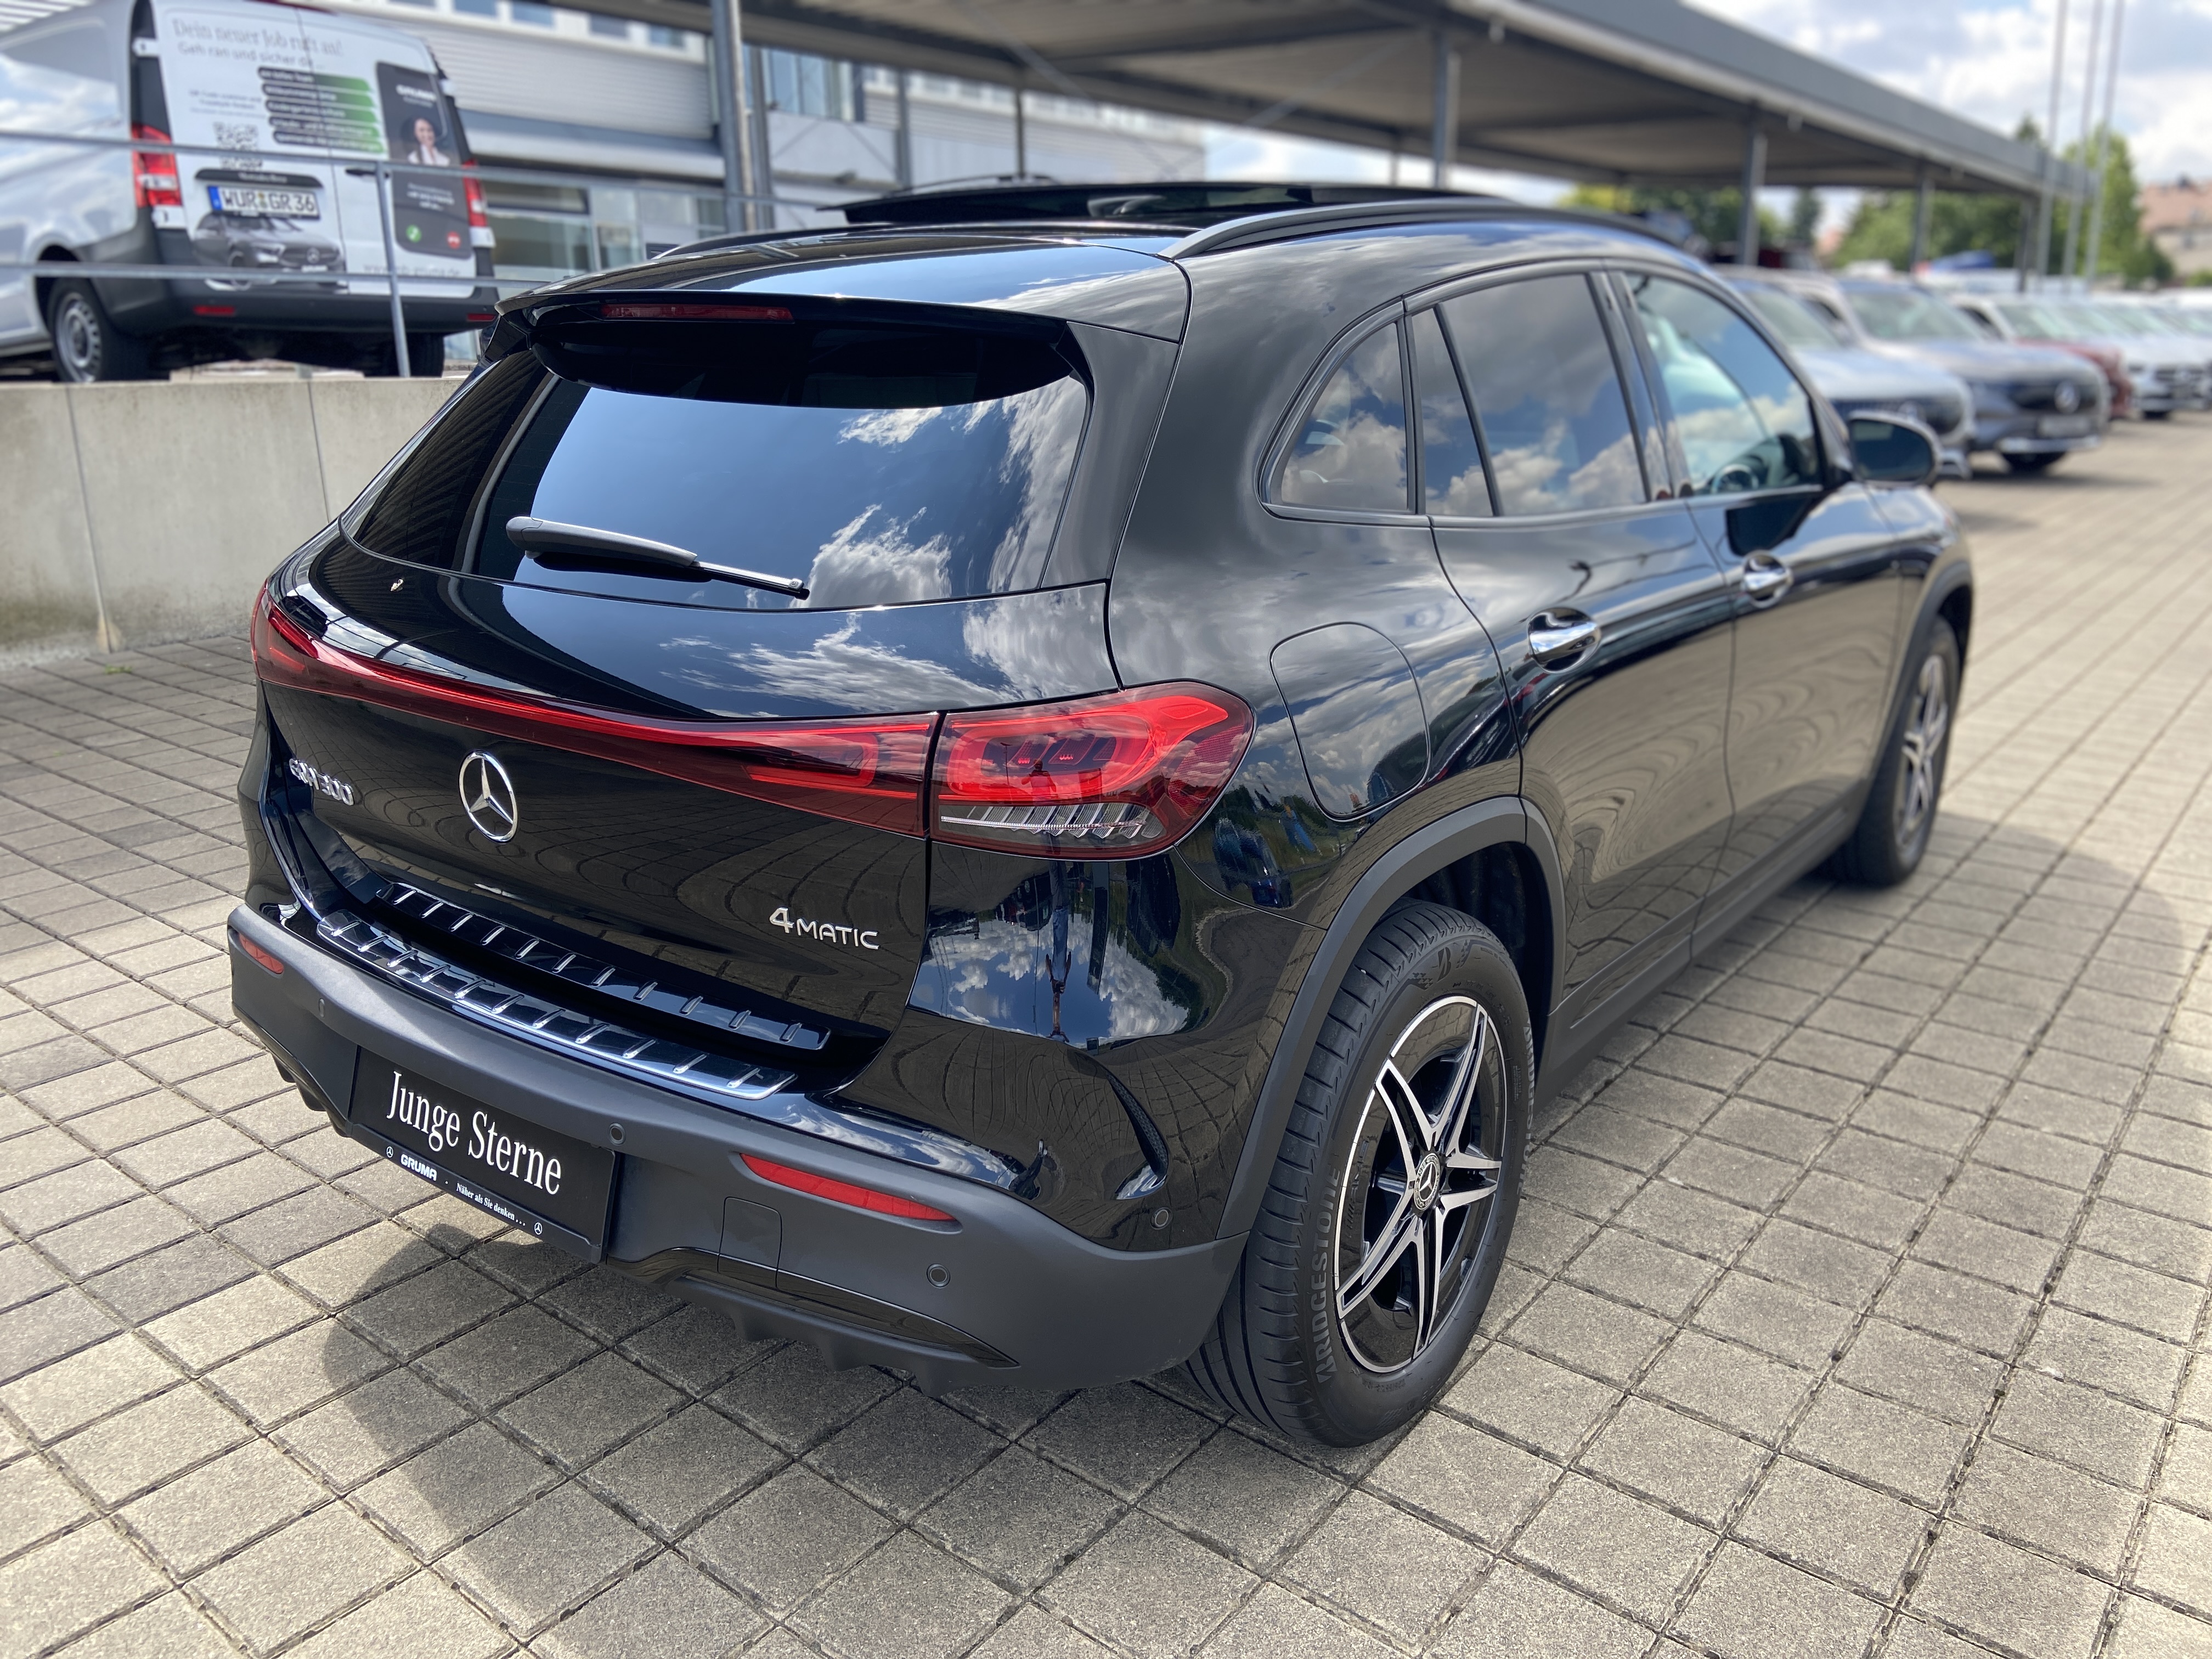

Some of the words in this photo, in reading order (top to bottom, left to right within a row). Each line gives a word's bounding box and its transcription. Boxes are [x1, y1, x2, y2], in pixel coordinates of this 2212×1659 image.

[173, 18, 212, 39] Dein
[215, 27, 259, 45] neuer
[262, 29, 289, 48] Job
[231, 50, 257, 62] und
[222, 190, 257, 208] WUR
[294, 194, 315, 212] 36
[318, 772, 354, 806] 300
[769, 906, 880, 950] 4MATIC
[386, 1071, 460, 1152] Junge
[468, 1111, 561, 1195] Sterne
[400, 1154, 437, 1181] GRUMA
[456, 1183, 475, 1199] Näher
[474, 1194, 483, 1204] als
[483, 1197, 493, 1209] Sie
[493, 1203, 515, 1221] denken
[1311, 1166, 1340, 1384] BRIDGESTONE
